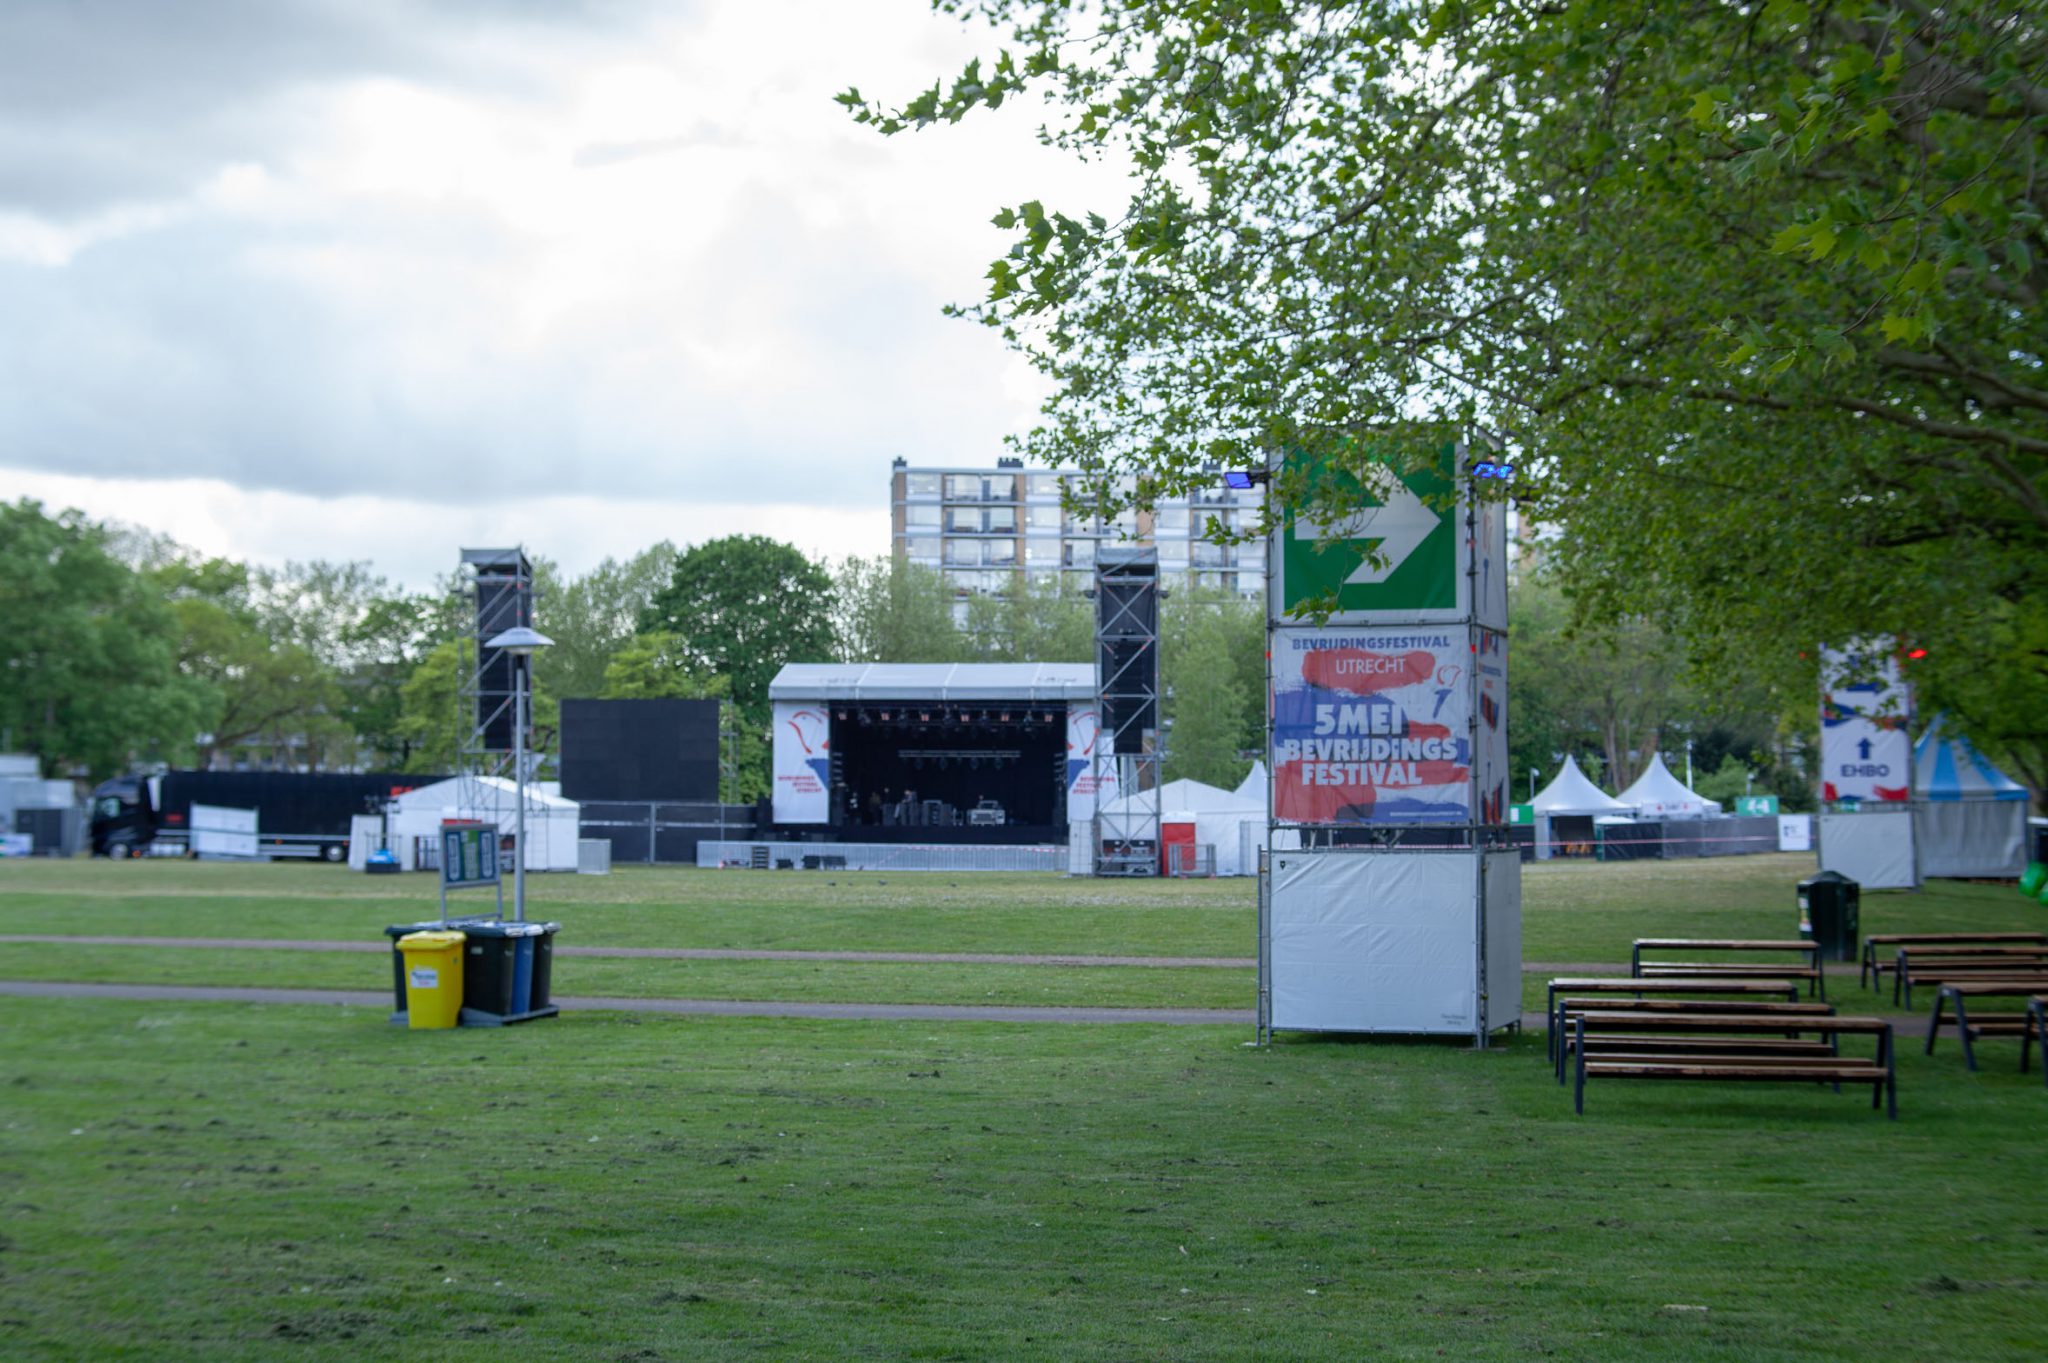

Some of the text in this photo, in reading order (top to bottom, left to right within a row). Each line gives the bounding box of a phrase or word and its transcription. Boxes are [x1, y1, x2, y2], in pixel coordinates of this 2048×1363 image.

[1292, 636, 1450, 650] BEVRIJDINGSFESTIVAL
[1335, 658, 1406, 674] UTRECHT
[1283, 737, 1458, 761] BEVRIJDINGS
[1301, 762, 1423, 785] FESTIVAL
[1840, 764, 1890, 778] EHBO
